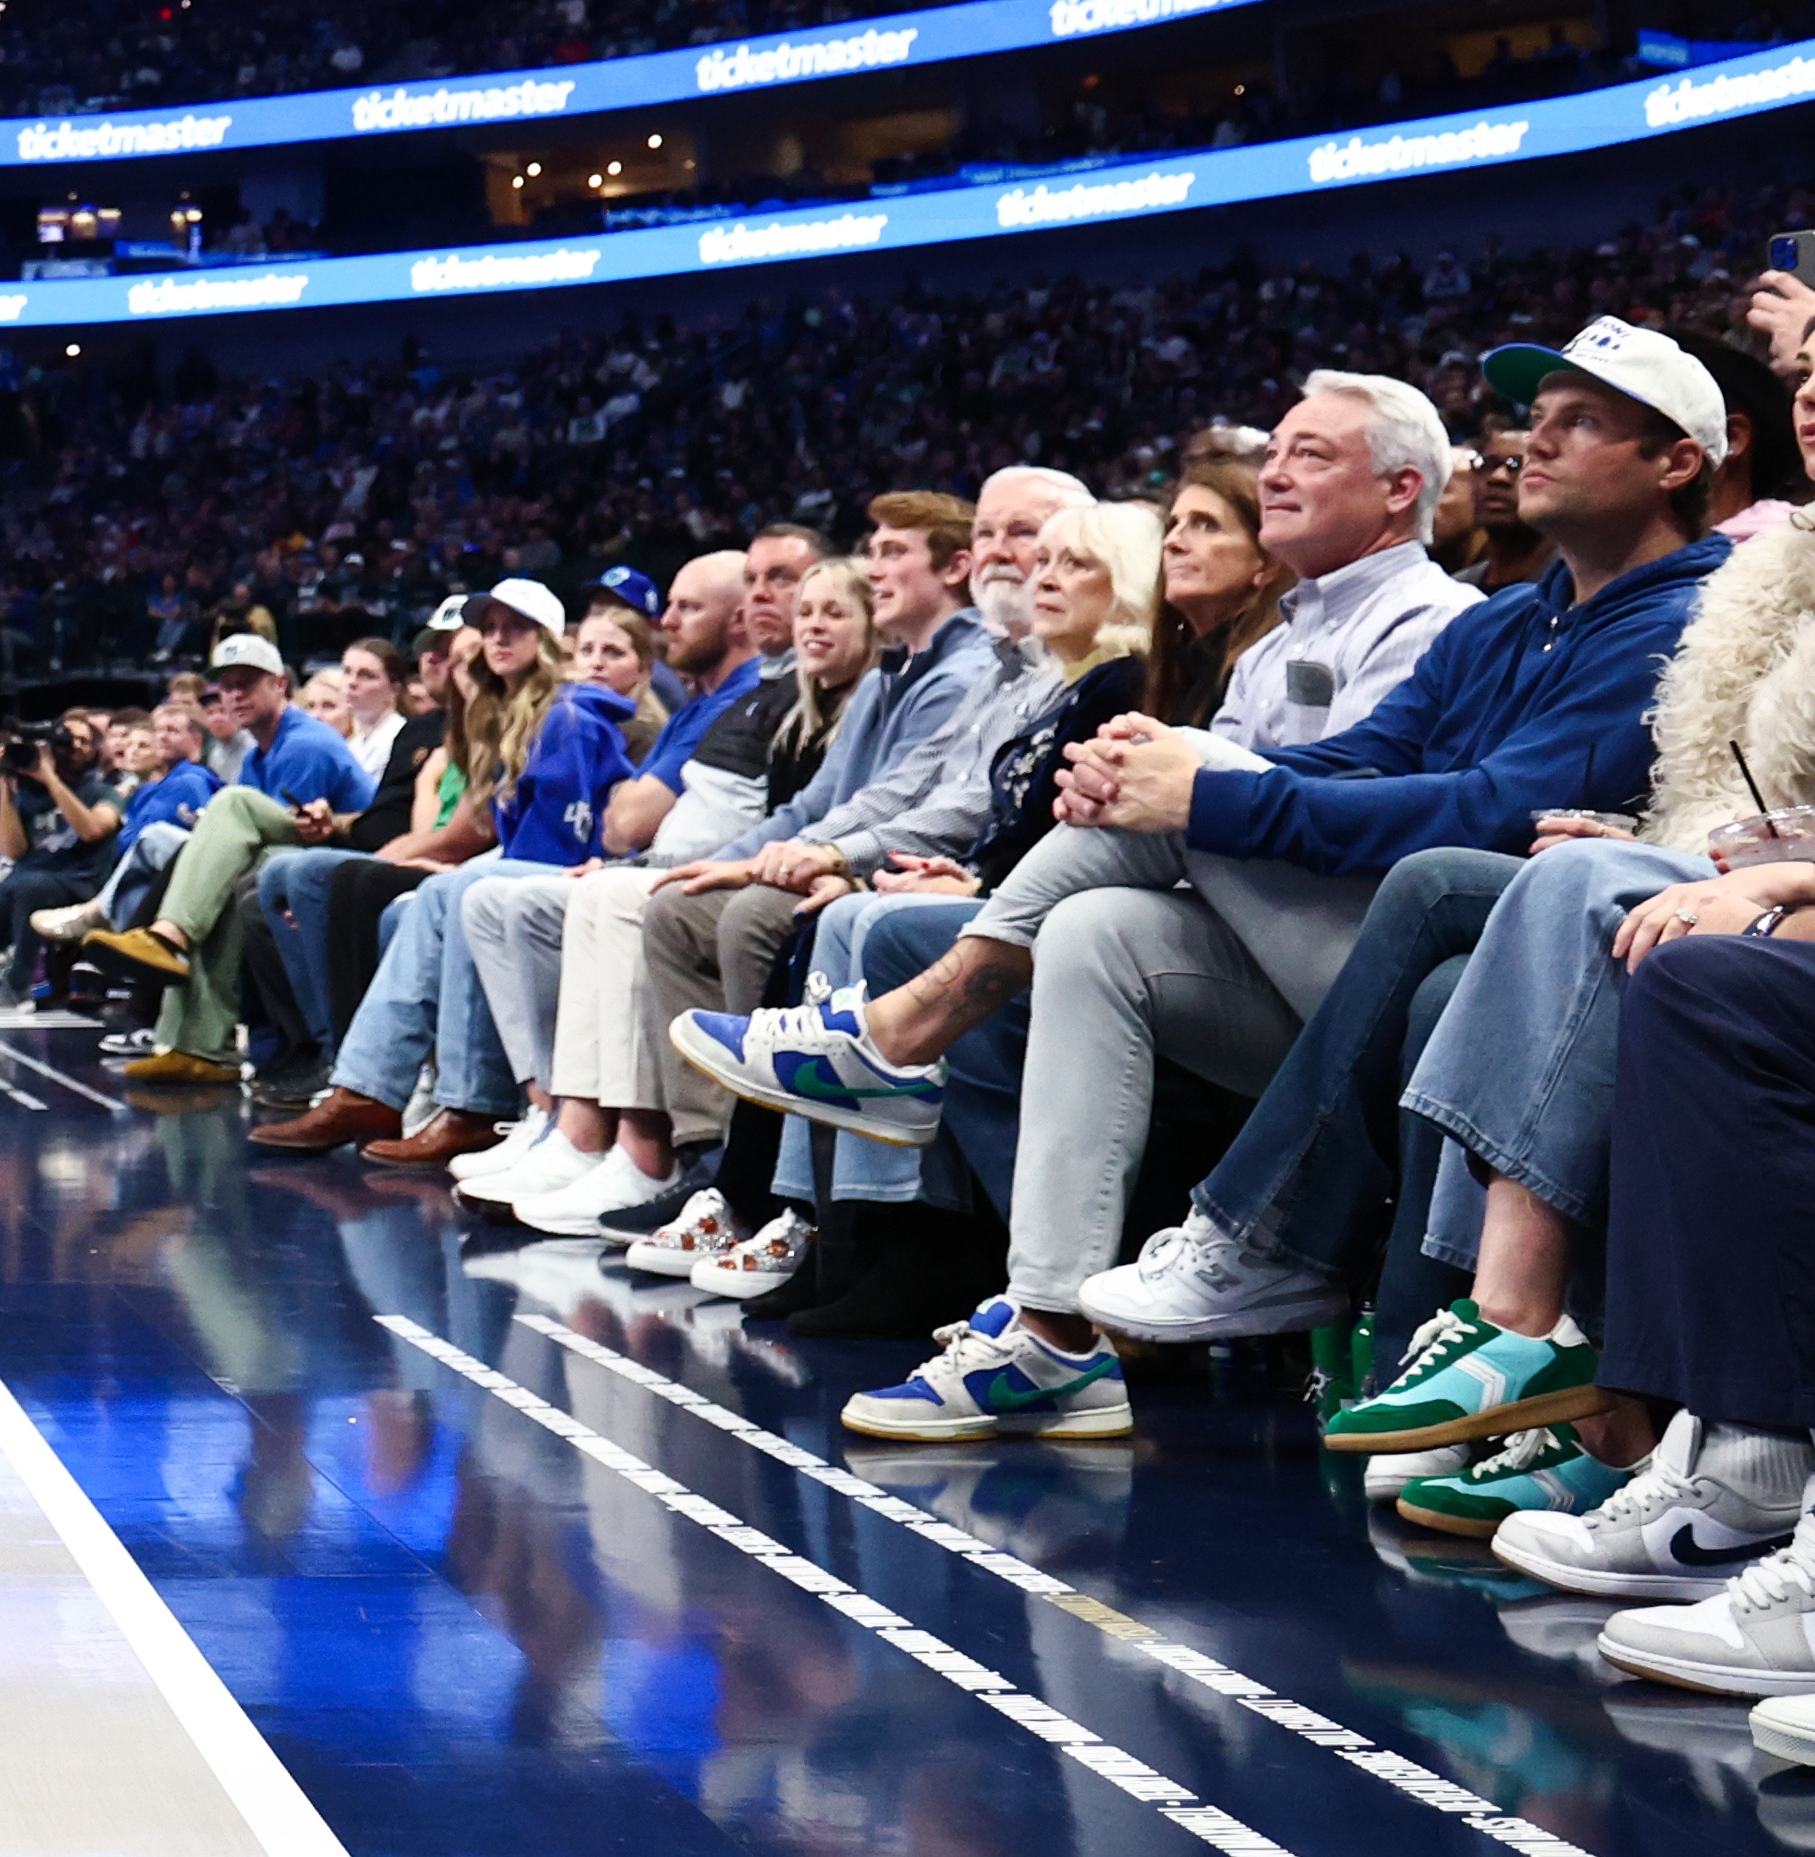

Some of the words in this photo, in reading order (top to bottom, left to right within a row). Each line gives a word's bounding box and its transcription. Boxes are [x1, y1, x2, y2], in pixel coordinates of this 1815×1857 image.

[696, 29, 918, 91] ticketmaster
[352, 80, 575, 130] ticketmaster
[1643, 55, 1815, 128] ticketmaste
[17, 115, 232, 160] ticketmaster
[1308, 121, 1529, 183] ticketmaster
[996, 172, 1195, 227] ticketmaster
[698, 214, 888, 264] ticketmaster
[127, 273, 309, 314] ticketmaster
[410, 248, 602, 292] ticketmaster
